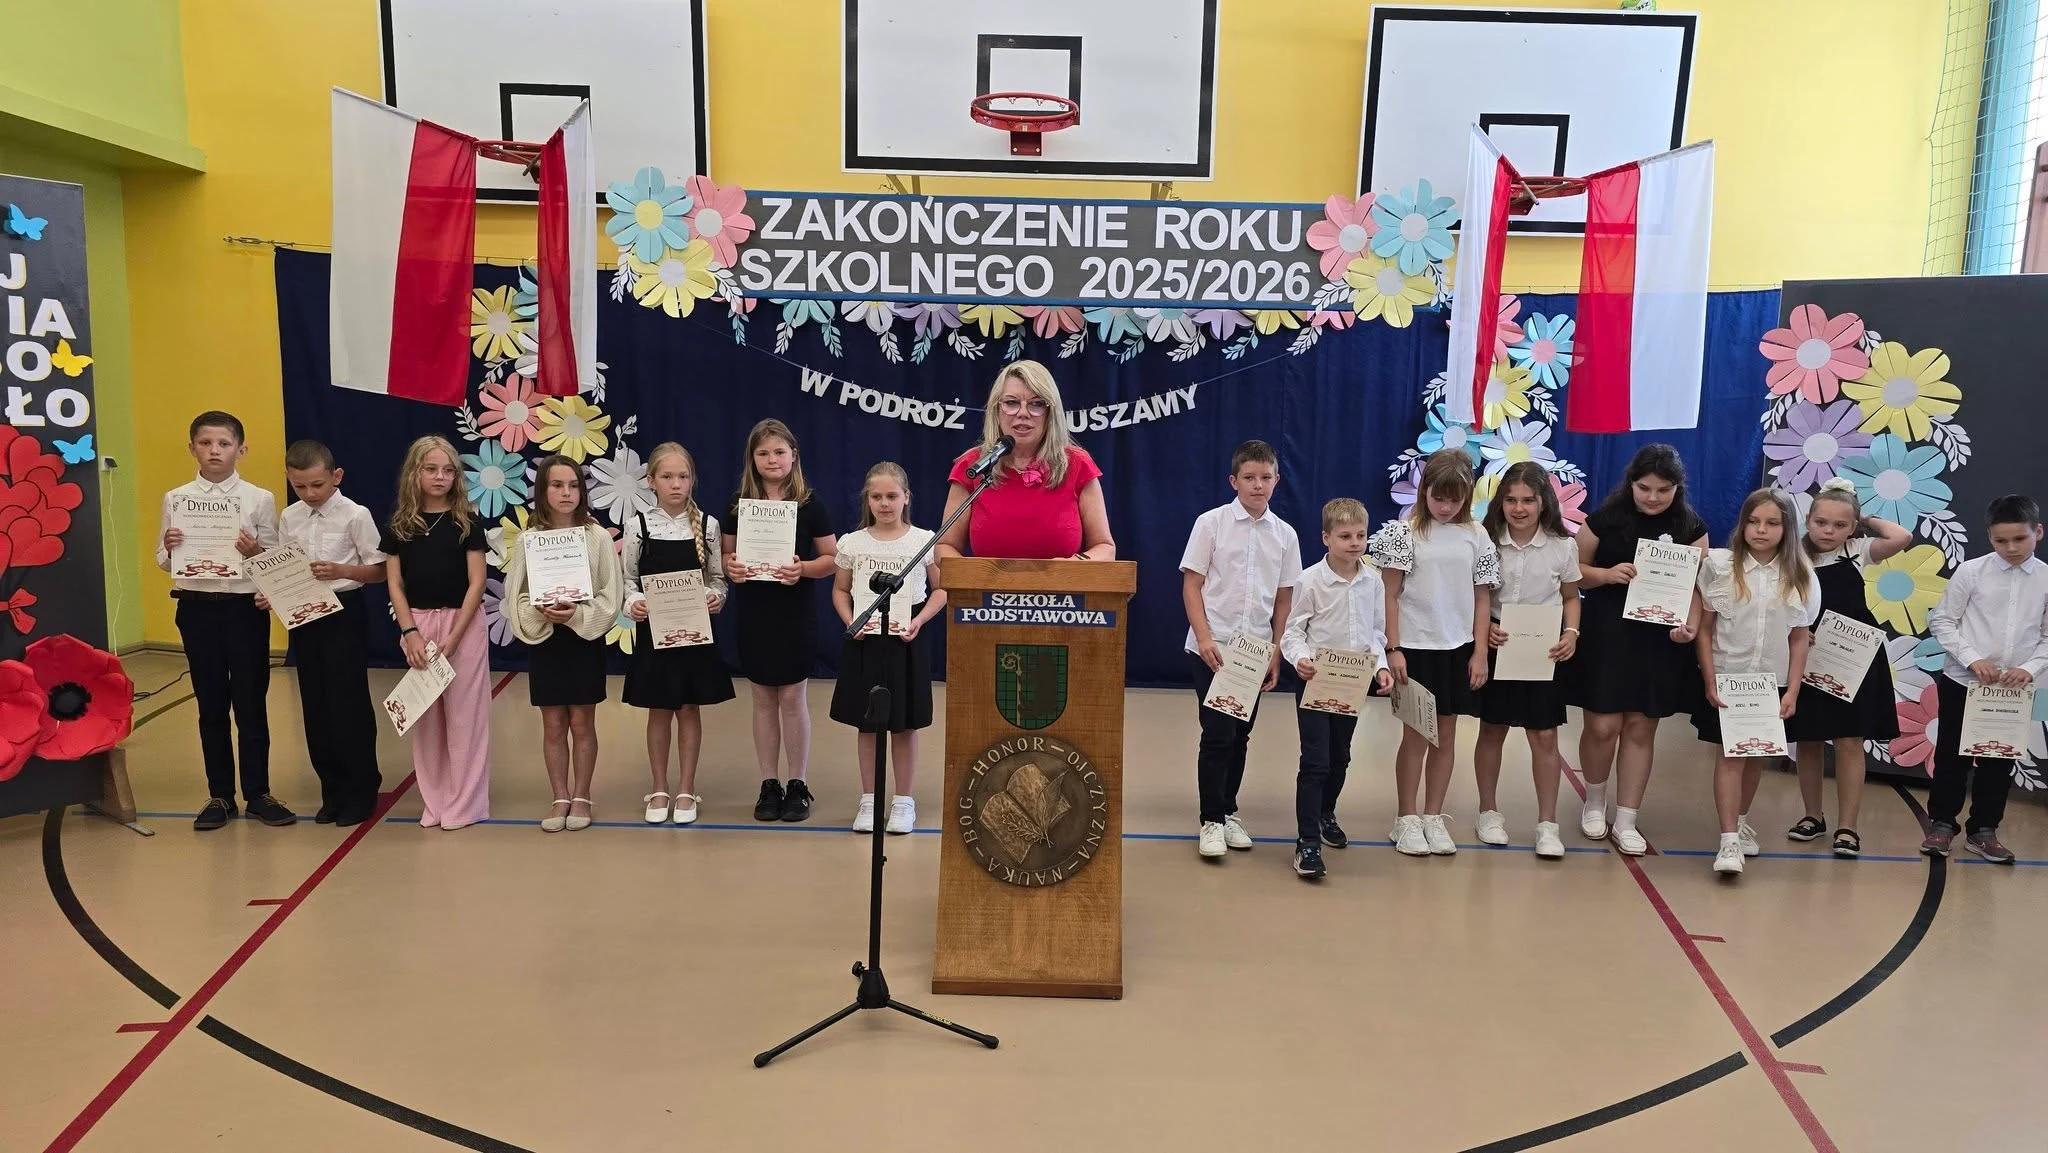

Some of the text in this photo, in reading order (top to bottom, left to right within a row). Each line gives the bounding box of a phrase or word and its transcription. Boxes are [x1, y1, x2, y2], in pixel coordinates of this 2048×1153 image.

[760, 195, 1302, 252] ZAKOŃCZENIE ROKU
[740, 248, 1311, 301] SZKOLNEGO 2025/2026
[0, 341, 53, 381] O
[800, 366, 1198, 433] W PODRÓŻ USZAMY
[187, 500, 228, 511] DYPLOM
[752, 505, 786, 517] DYPLOM
[538, 535, 574, 546] DYPLOM
[256, 551, 295, 570] DYPLOM
[1650, 546, 1687, 562] DYPLOM
[869, 559, 902, 570] DYPLOM
[655, 578, 692, 589] DYPLOM
[991, 593, 1075, 608] SZKOŁA
[961, 608, 1107, 624] PODSTAWOWA
[1833, 620, 1871, 641] DYPLOM
[1238, 638, 1265, 657] DYPLOM
[1328, 653, 1364, 666] DYPLOM
[1730, 679, 1766, 691] DYPLOM
[1982, 687, 2021, 698] DYPLOM
[972, 736, 1045, 776] HONOR
[1067, 751, 1106, 860] OJCZYZNA
[988, 857, 1063, 886] NAUKA
